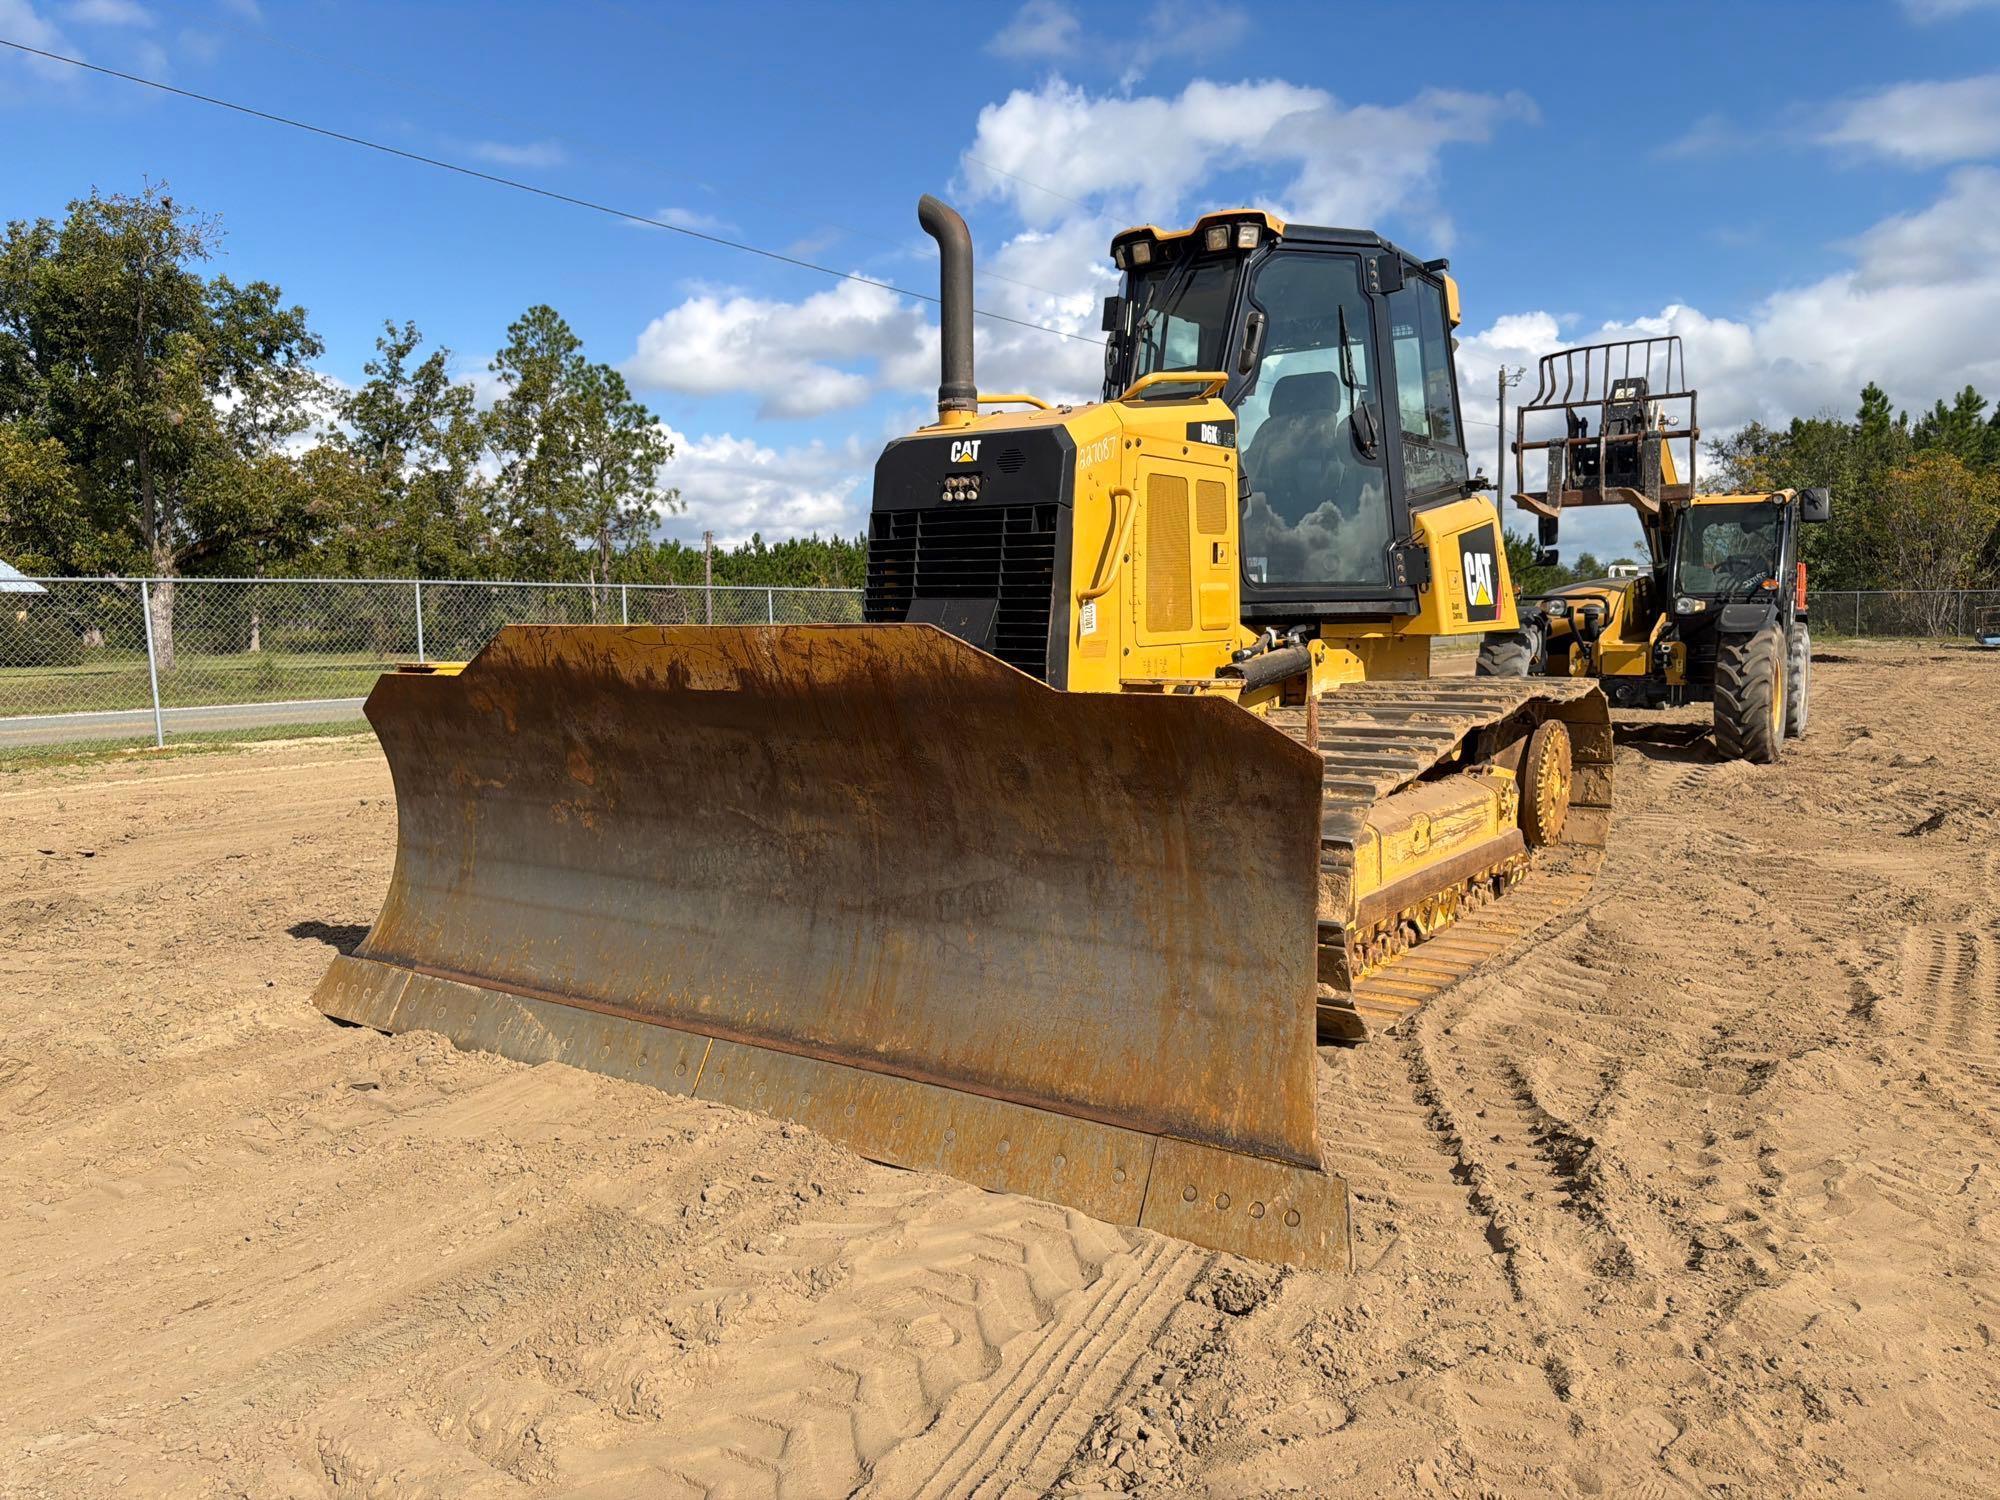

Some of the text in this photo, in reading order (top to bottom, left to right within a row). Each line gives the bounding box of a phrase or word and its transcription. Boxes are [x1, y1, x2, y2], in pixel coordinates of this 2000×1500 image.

[950, 440, 982, 463] CAT
[1079, 436, 1117, 470] 227087
[1463, 551, 1494, 606] CAT
